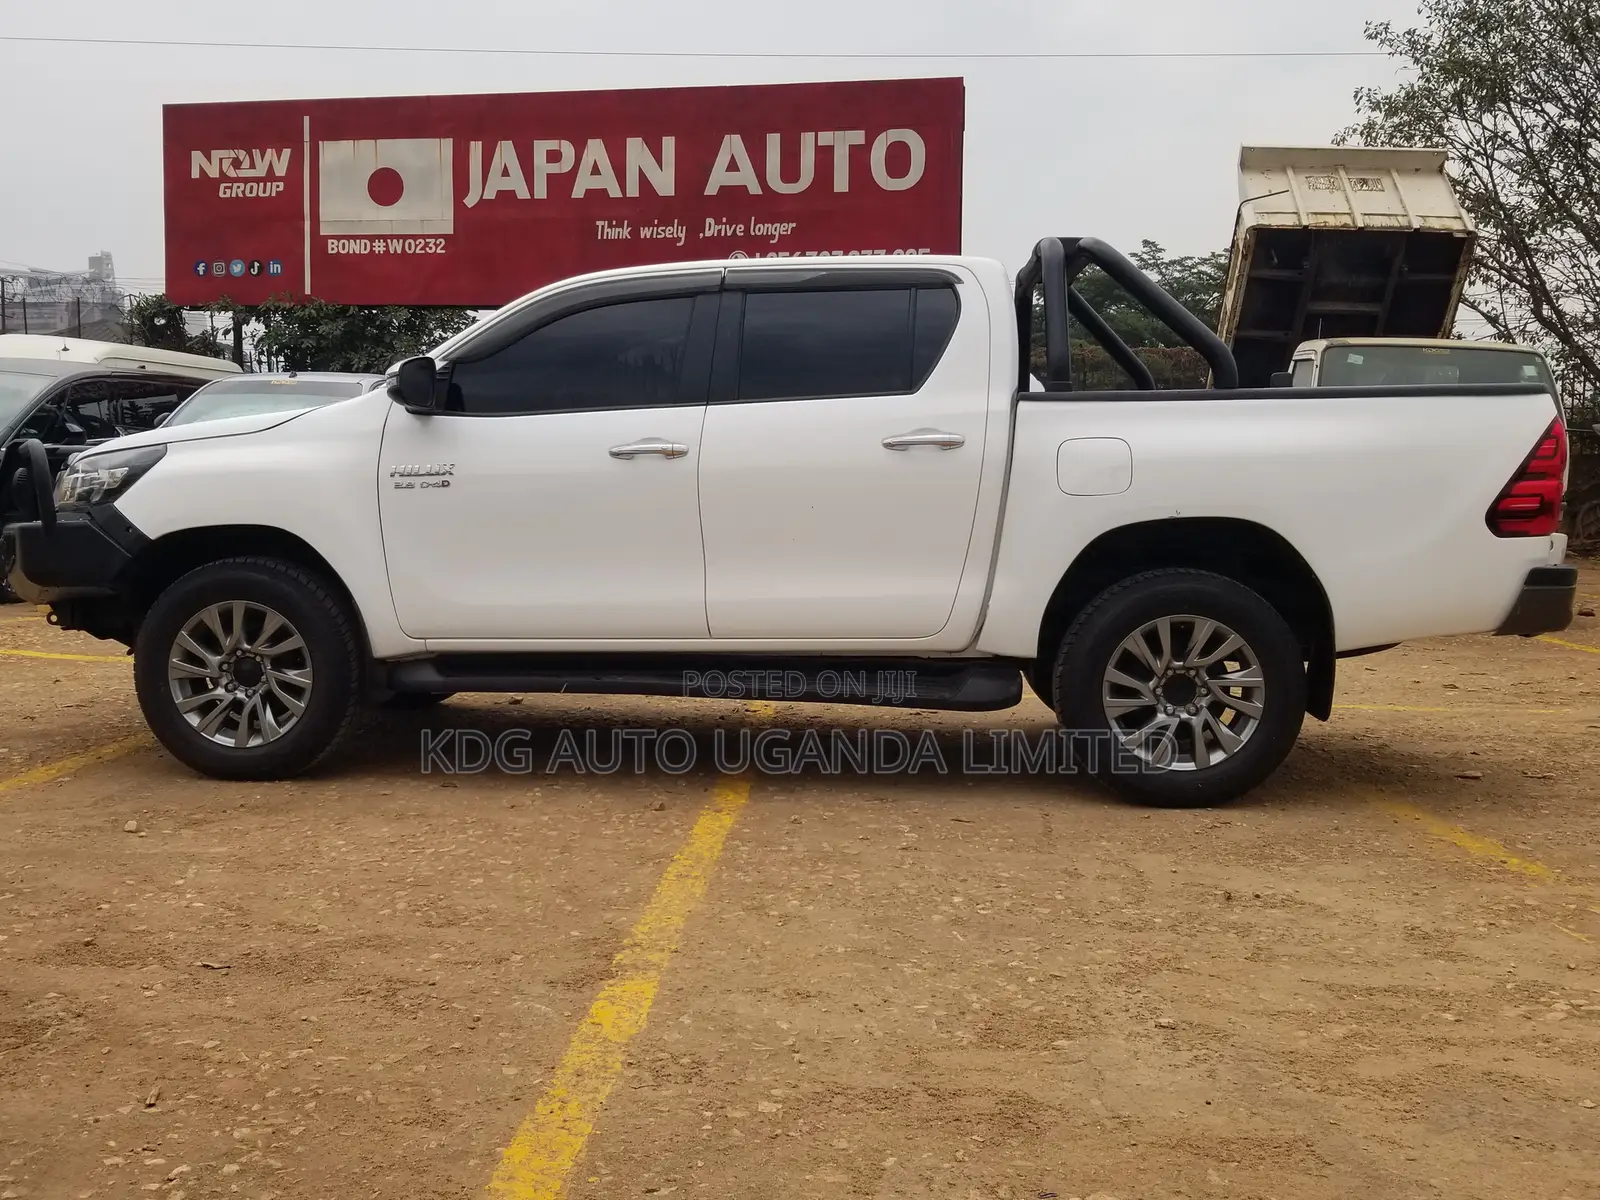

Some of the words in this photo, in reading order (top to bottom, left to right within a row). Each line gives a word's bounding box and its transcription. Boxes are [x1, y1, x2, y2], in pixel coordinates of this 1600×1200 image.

[463, 136, 675, 208] JAPAN
[704, 128, 926, 196] AUTO
[218, 181, 284, 198] GROUP
[596, 220, 632, 240] Think
[640, 219, 686, 246] wisely
[750, 216, 796, 243] longer
[390, 463, 455, 478] HILUX
